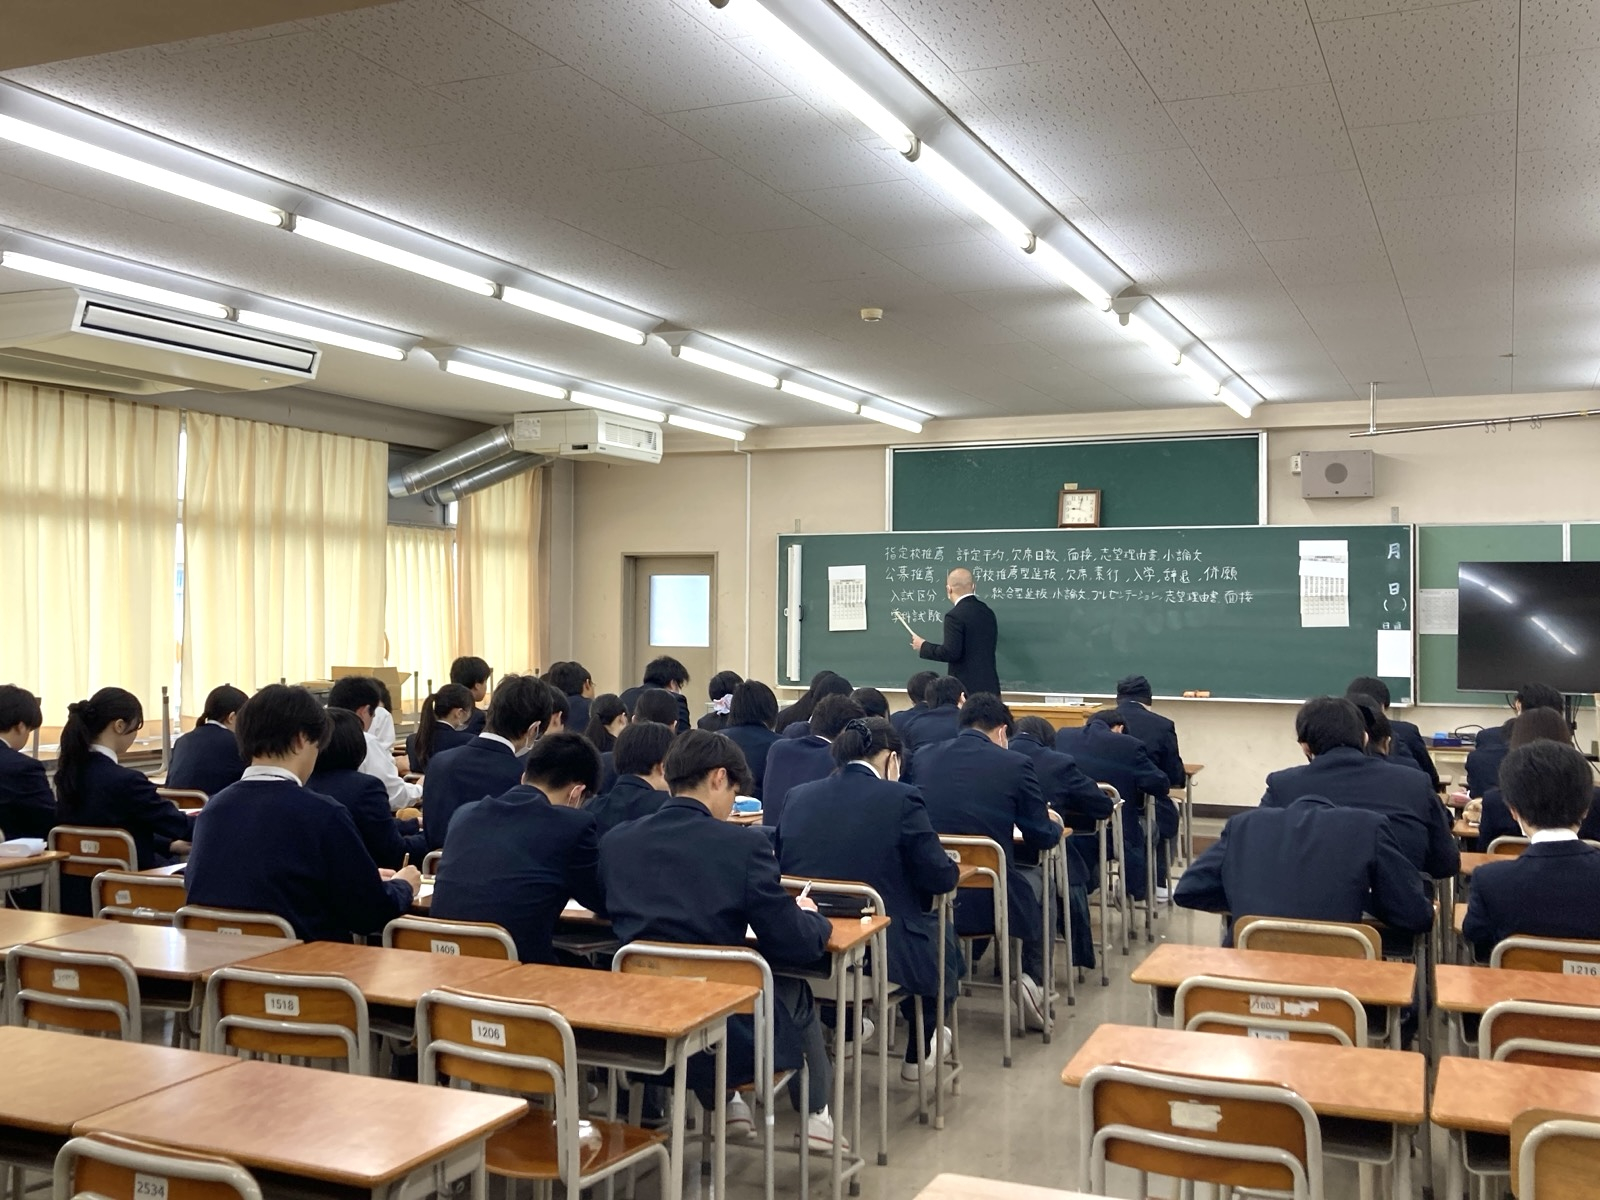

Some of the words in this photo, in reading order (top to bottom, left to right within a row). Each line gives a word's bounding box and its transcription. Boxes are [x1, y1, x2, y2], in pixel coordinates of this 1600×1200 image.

[1387, 542, 1401, 559] 月
[1388, 582, 1400, 595] 日
[435, 943, 456, 955] 1409
[1570, 964, 1597, 976] 1216
[270, 997, 295, 1012] 1518
[477, 1025, 501, 1040] 1206
[136, 1180, 166, 1198] 2534
